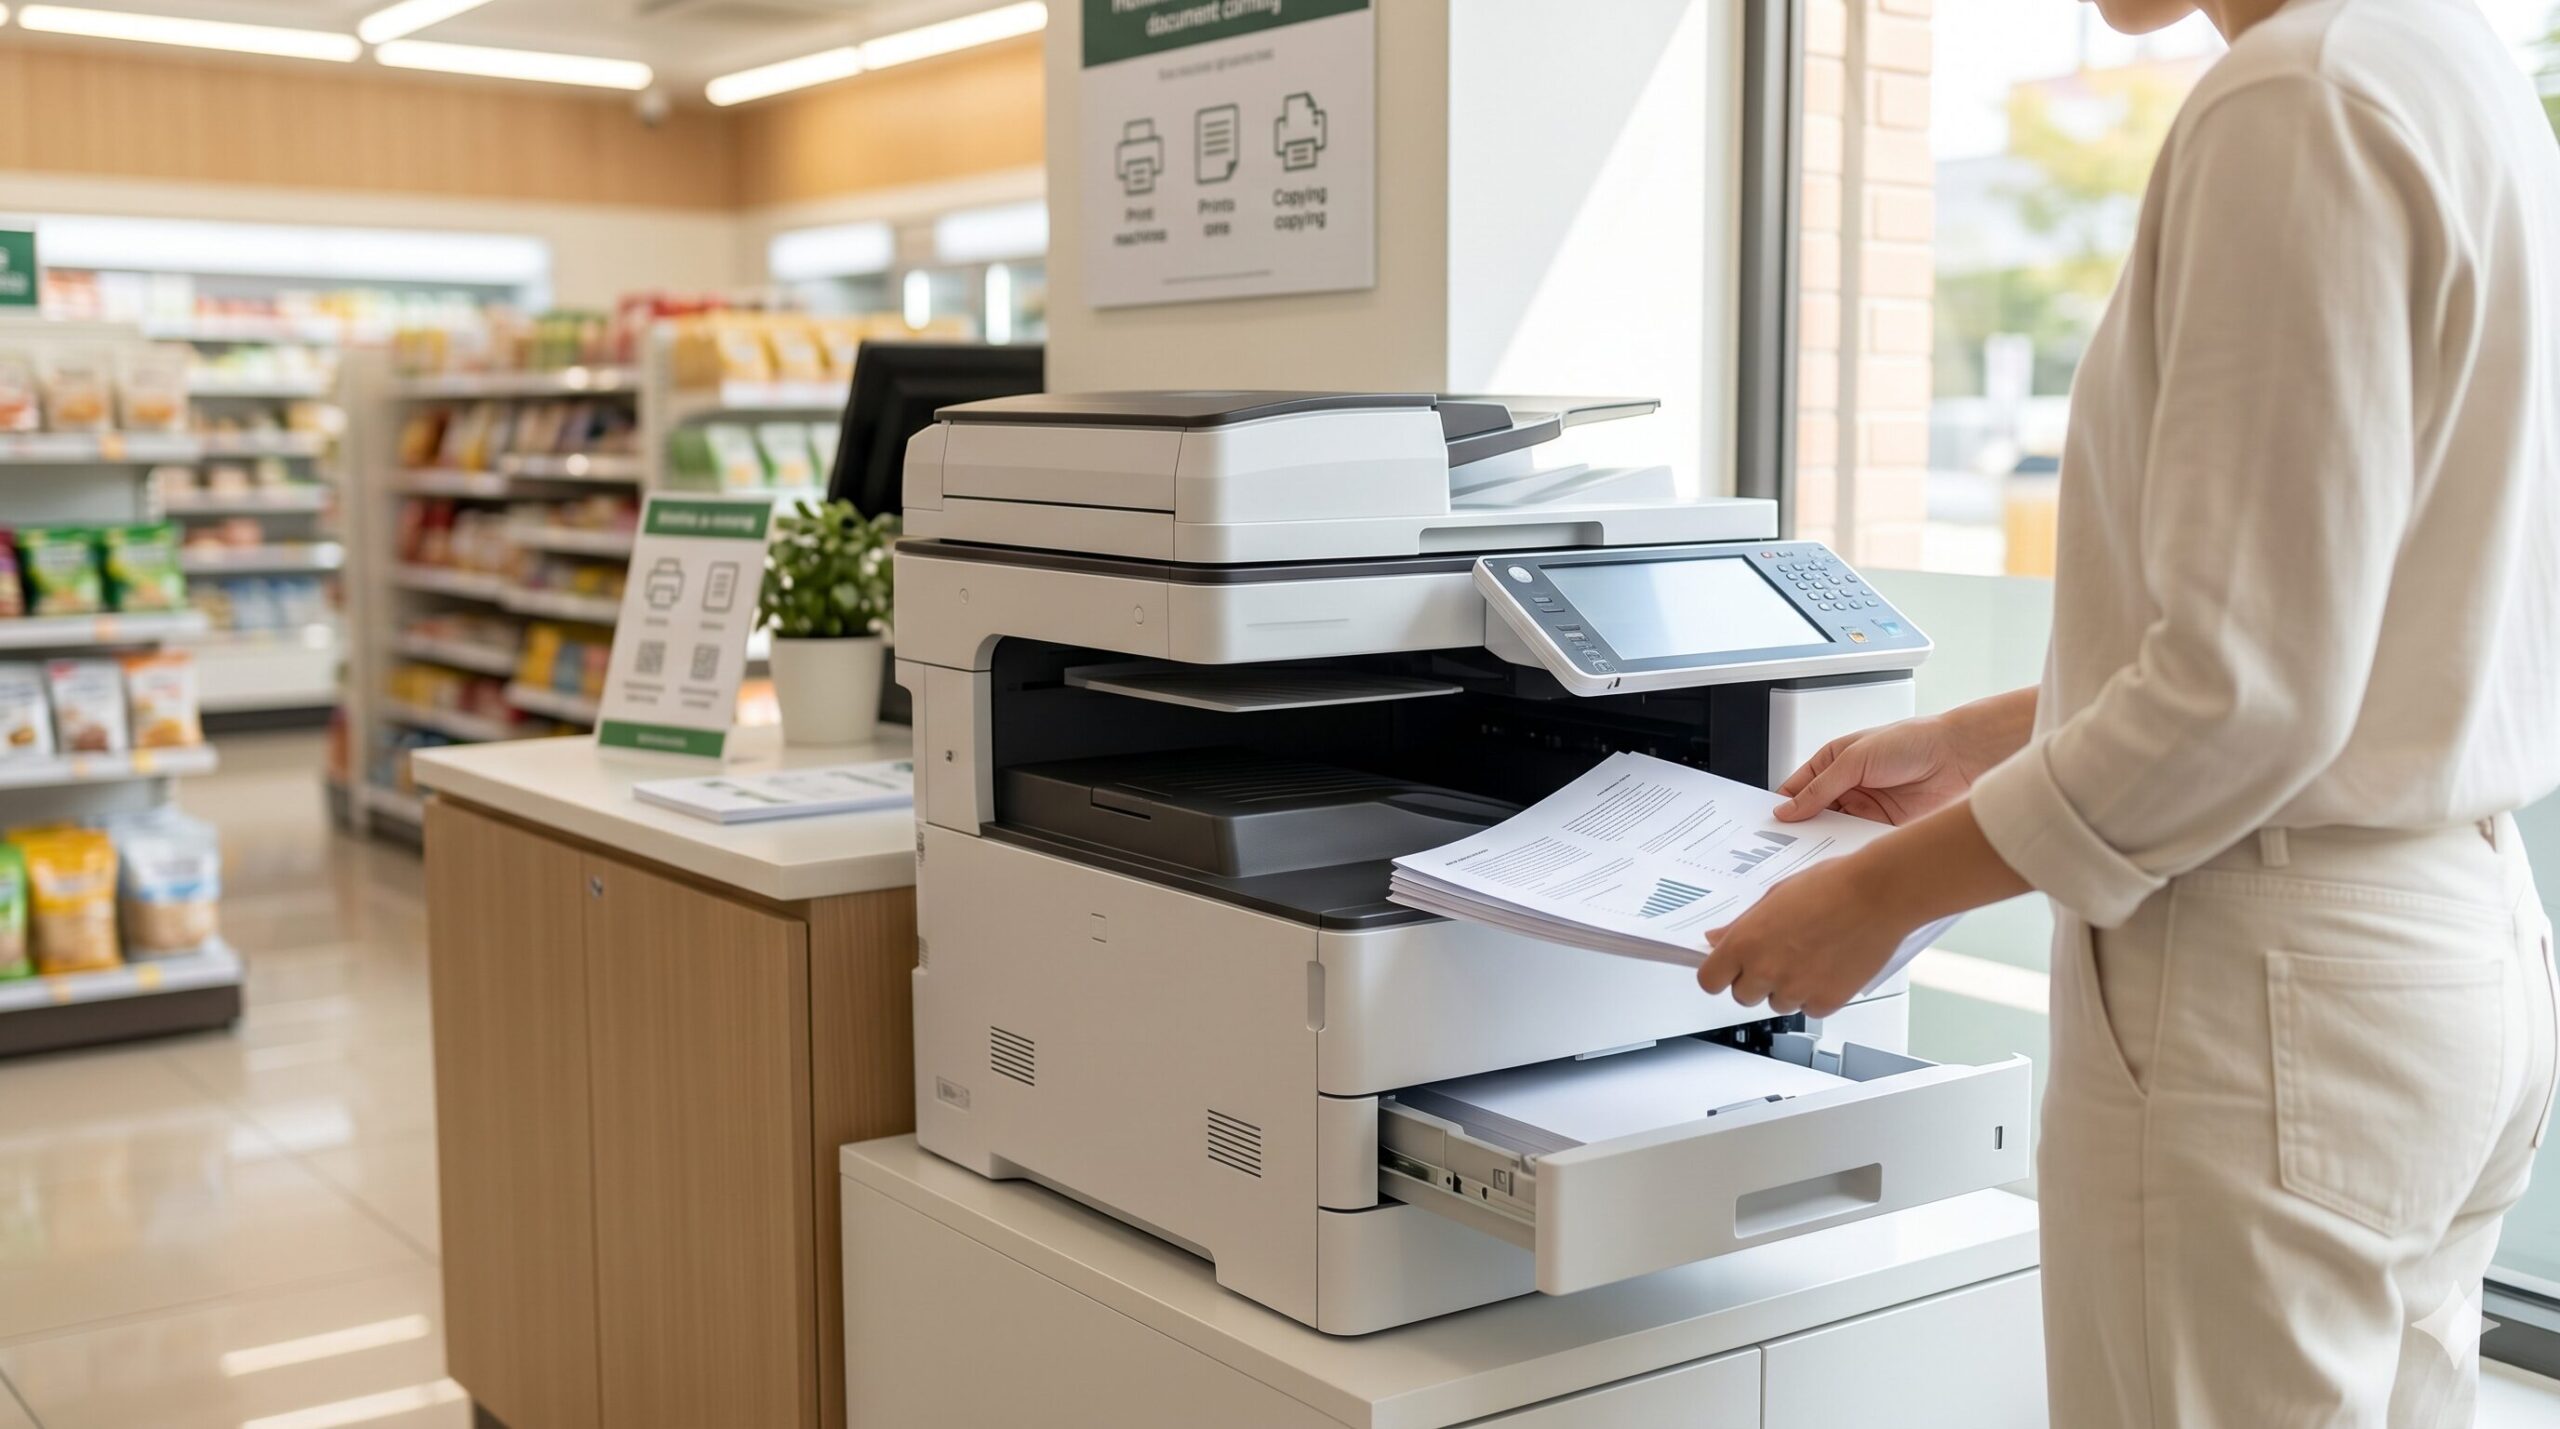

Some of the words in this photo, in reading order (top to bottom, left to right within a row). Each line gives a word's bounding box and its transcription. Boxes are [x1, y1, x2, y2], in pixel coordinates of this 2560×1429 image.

[1145, 1, 1220, 36] document
[1273, 187, 1328, 207] Copying
[1274, 211, 1327, 231] copying
